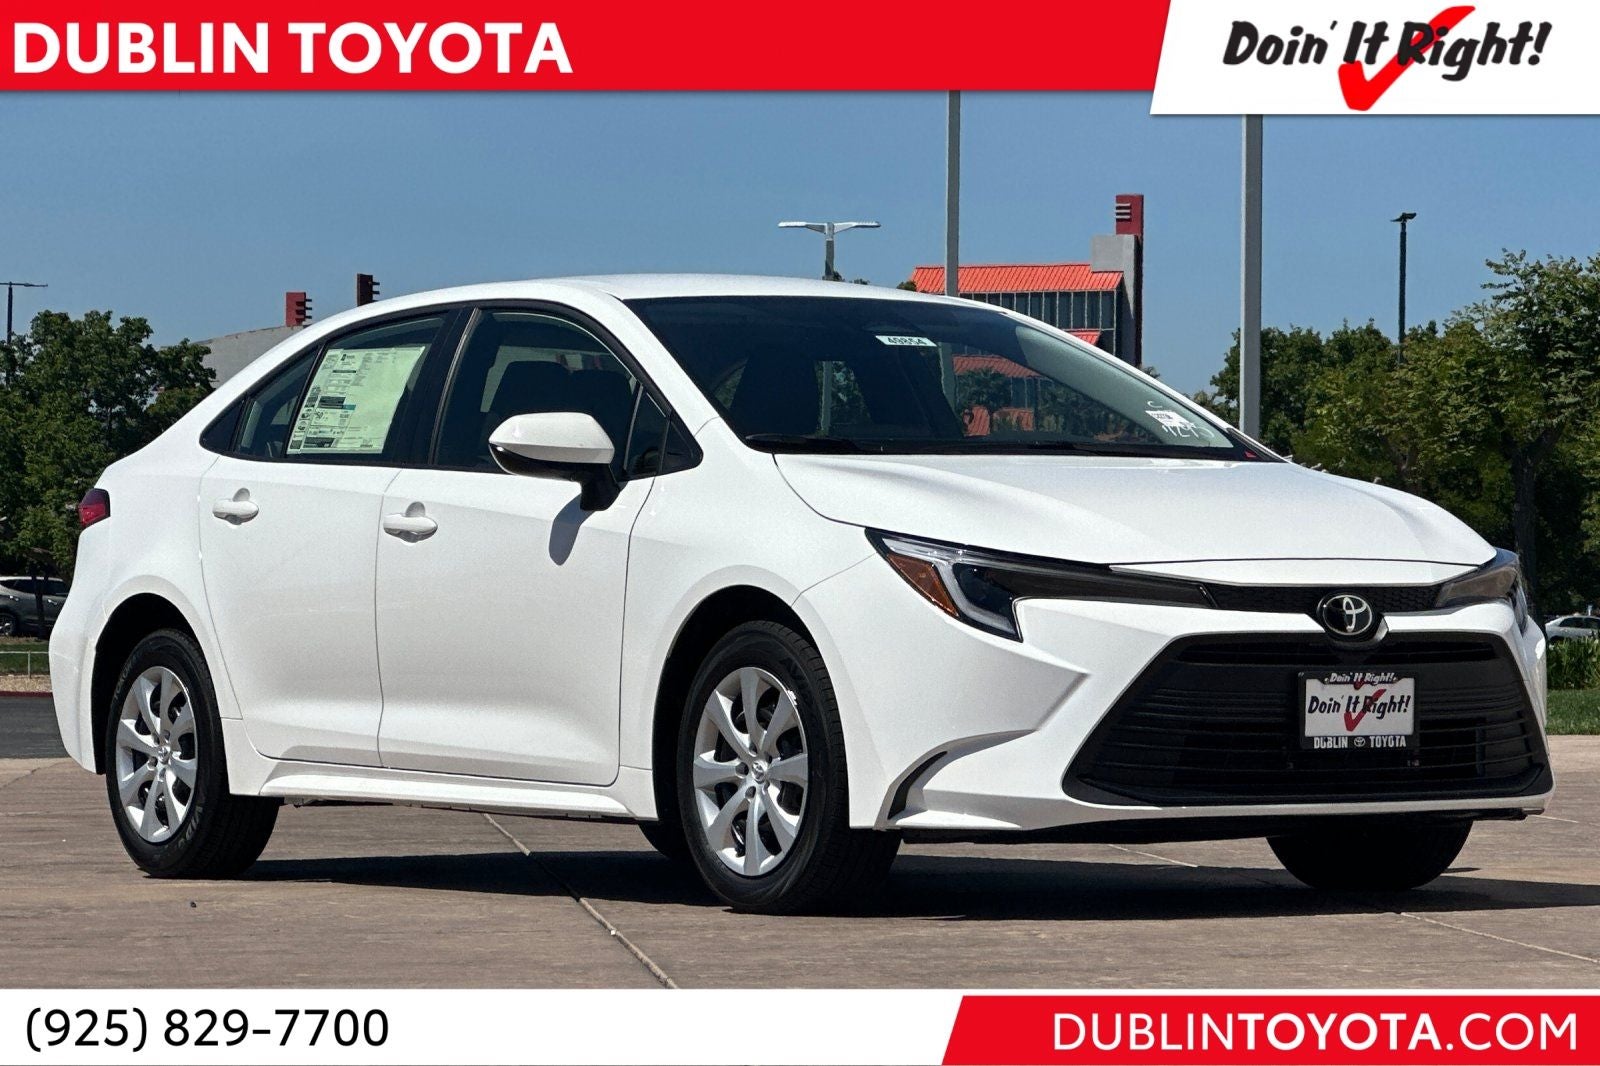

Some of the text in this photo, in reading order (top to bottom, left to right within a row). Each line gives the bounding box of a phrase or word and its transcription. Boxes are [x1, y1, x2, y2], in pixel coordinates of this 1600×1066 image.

[1354, 672, 1363, 682] It
[1364, 672, 1395, 686] Right!
[1307, 694, 1411, 719] Doin' It Right!
[1313, 735, 1407, 749] DUBLIN TOYOTA
